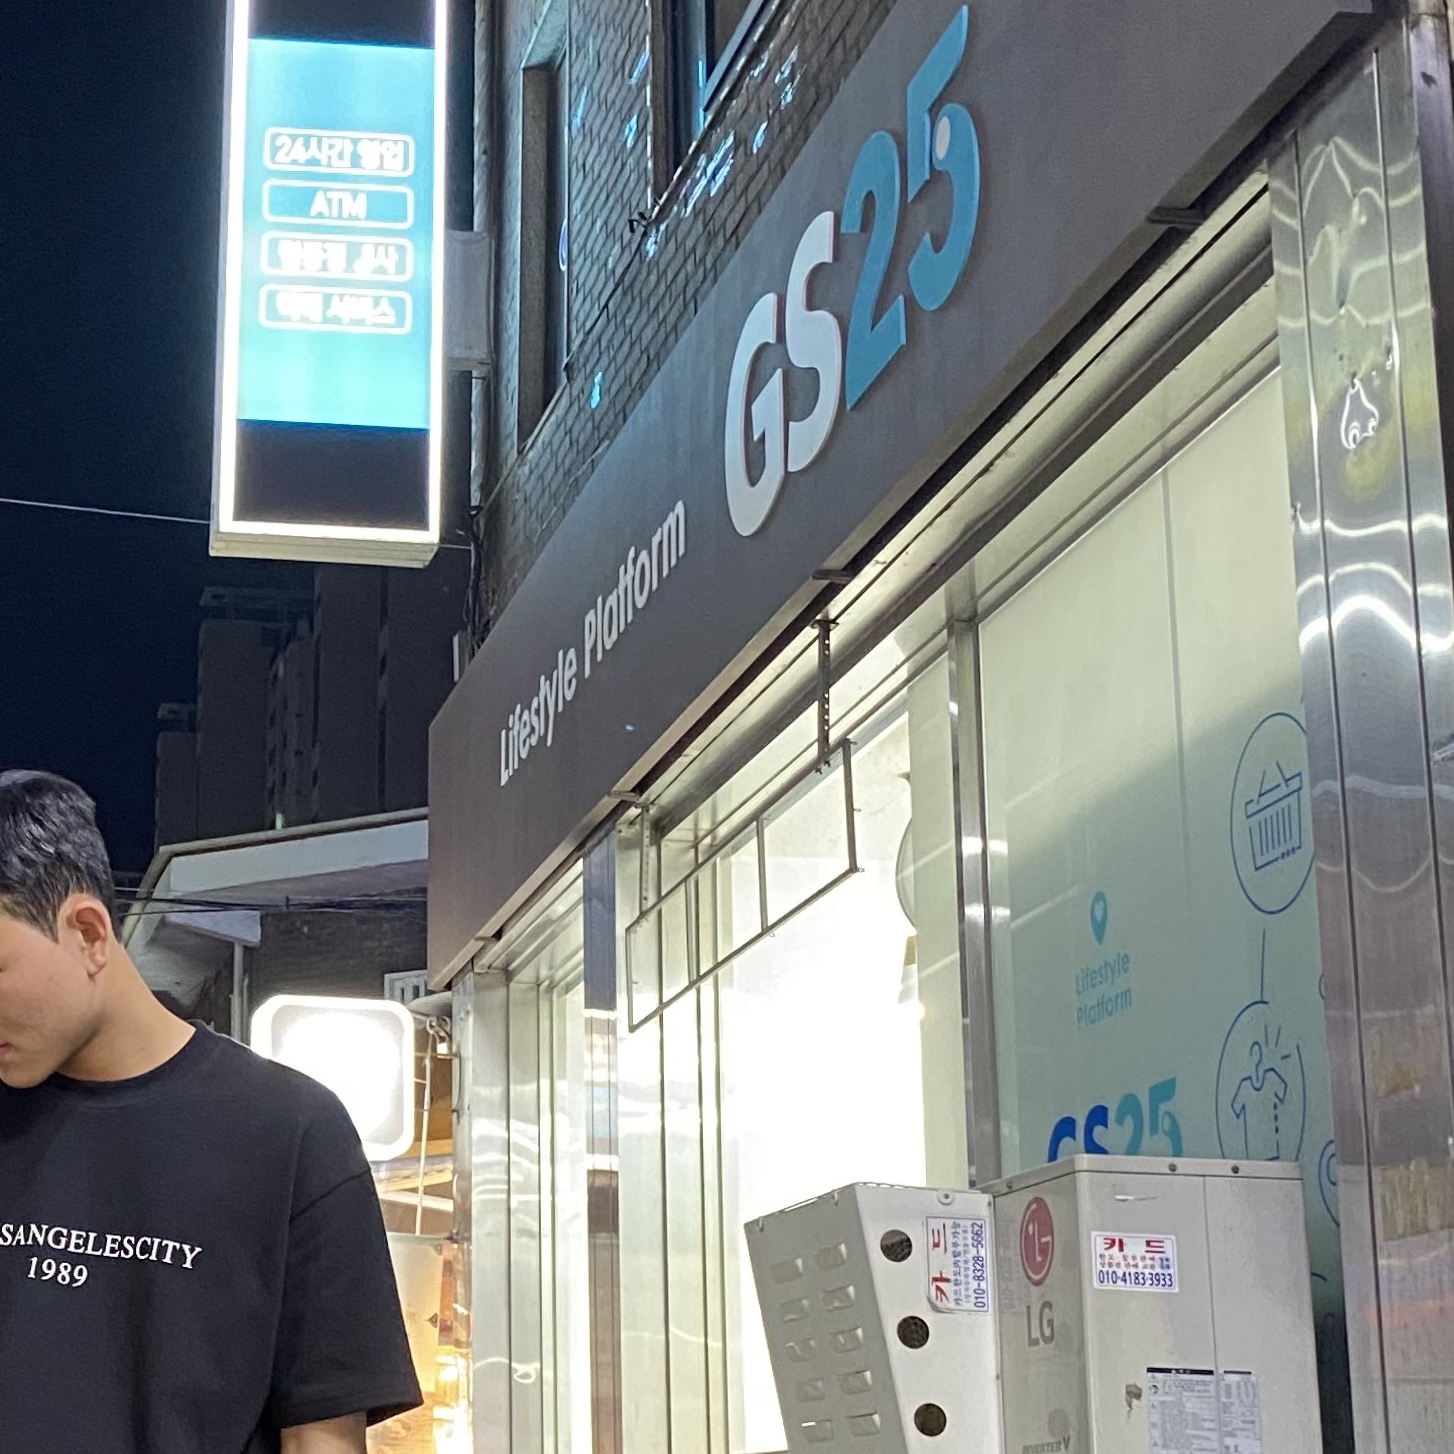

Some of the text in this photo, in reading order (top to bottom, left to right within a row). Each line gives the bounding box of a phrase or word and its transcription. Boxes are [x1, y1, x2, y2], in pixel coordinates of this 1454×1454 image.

[310, 190, 367, 220] ATM
[724, 4, 981, 538] GS25
[500, 500, 686, 788] Lifestyle Platform
[1075, 952, 1130, 997] Lifestyle
[1076, 987, 1132, 1030] Platform
[931, 1222, 953, 1304] 카드
[1103, 1237, 1166, 1254] 카드
[27, 1256, 88, 1288] 1989
[1098, 1269, 1174, 1288] 010-4183-3933
[1026, 1300, 1055, 1347] LG
